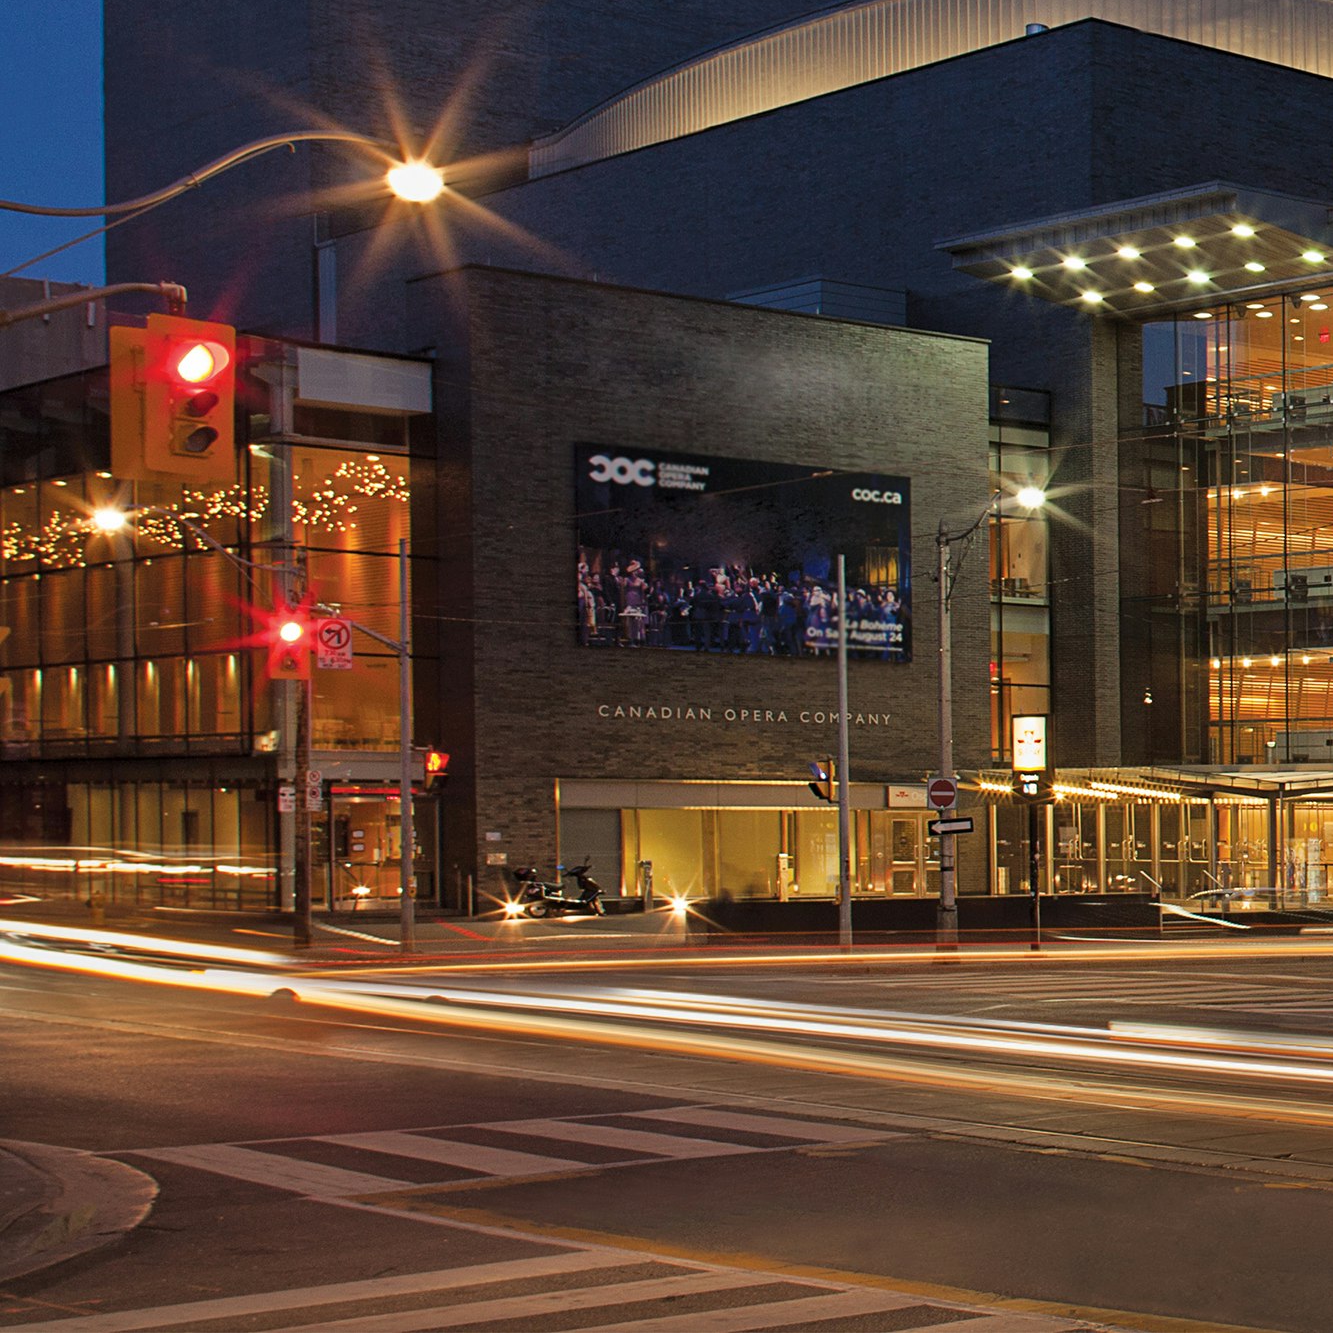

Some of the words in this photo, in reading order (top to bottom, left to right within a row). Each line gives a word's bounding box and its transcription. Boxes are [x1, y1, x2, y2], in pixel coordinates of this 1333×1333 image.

[658, 462, 710, 476] CANADIAN
[658, 470, 692, 482] OPERA
[658, 478, 706, 491] COMPANY
[851, 487, 902, 505] coc.ca
[806, 626, 823, 637] On
[850, 630, 887, 643] August
[598, 704, 711, 720] CANADIAN
[724, 708, 788, 723] OPERA
[799, 711, 892, 726] COMPANY
